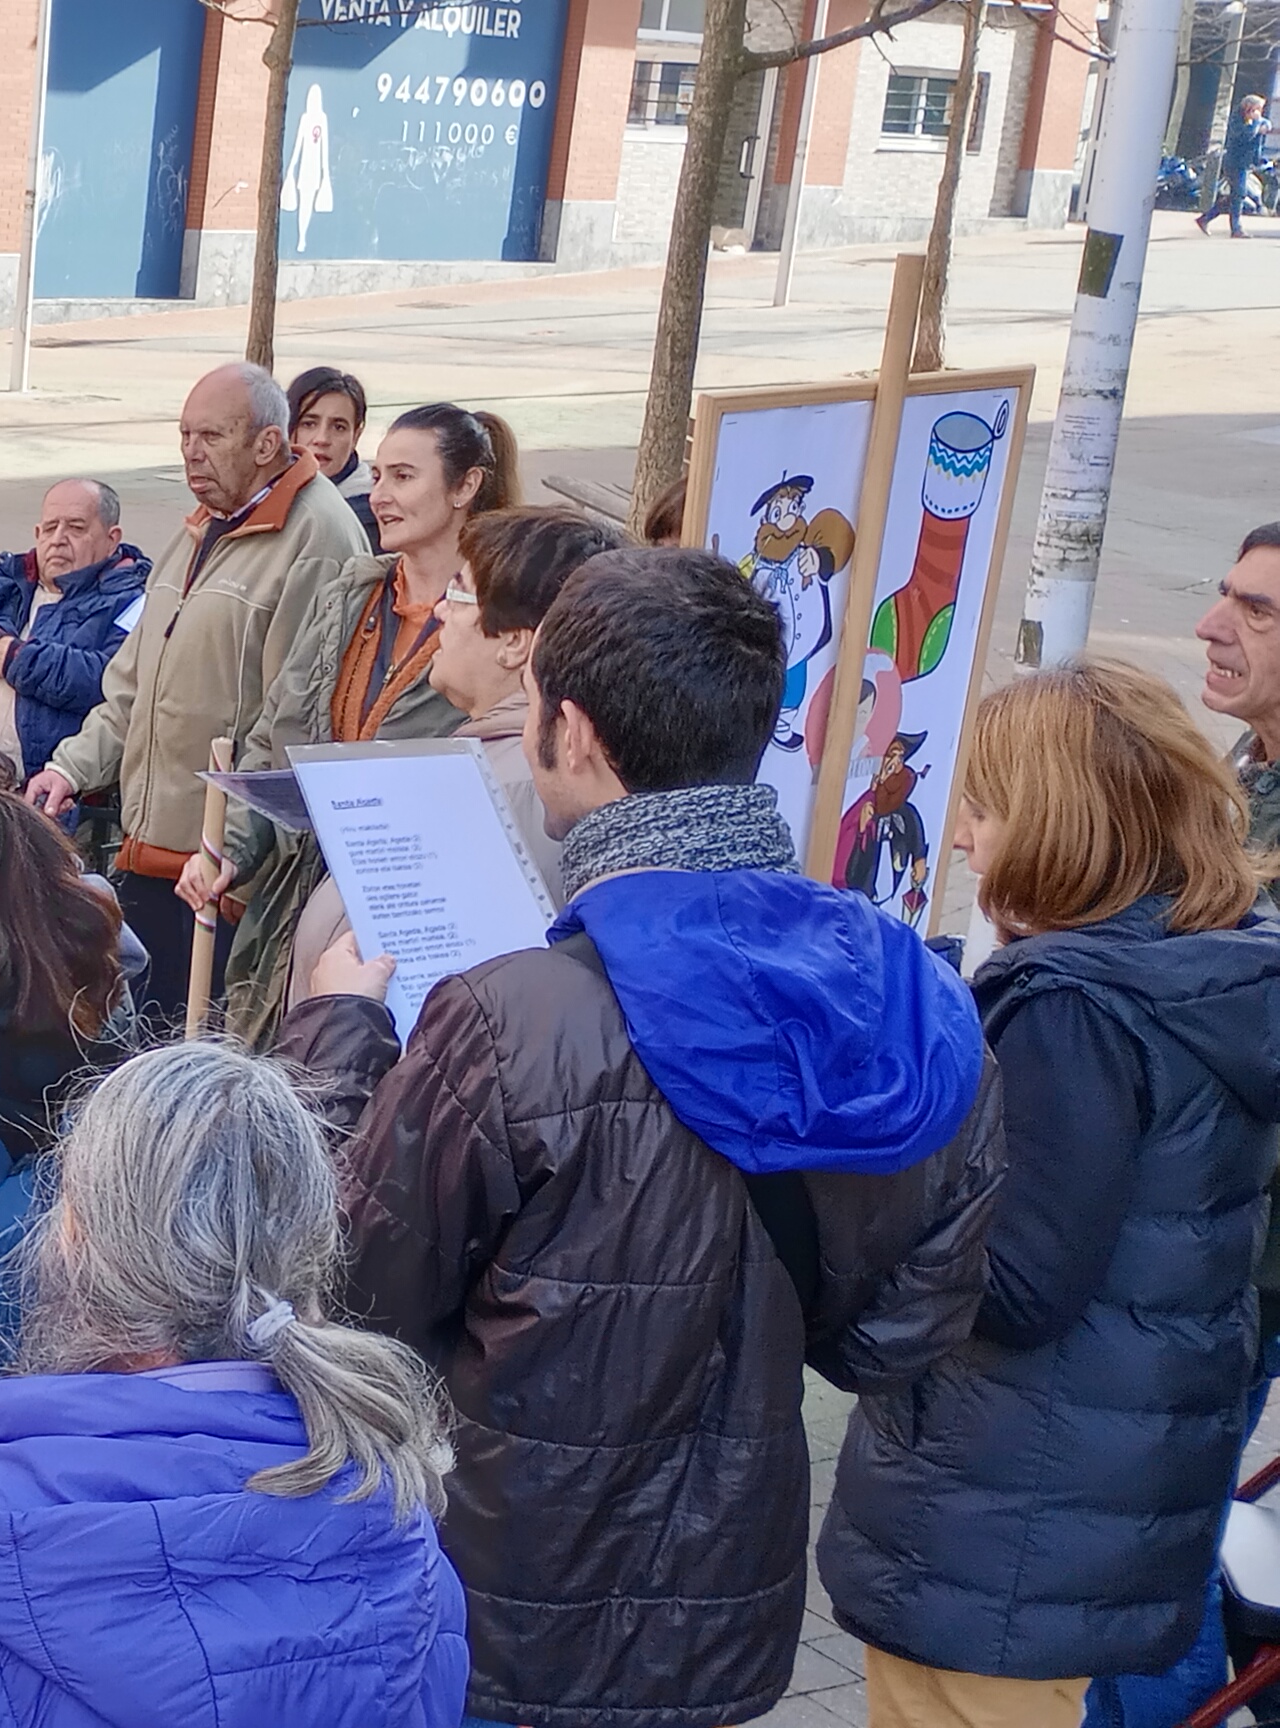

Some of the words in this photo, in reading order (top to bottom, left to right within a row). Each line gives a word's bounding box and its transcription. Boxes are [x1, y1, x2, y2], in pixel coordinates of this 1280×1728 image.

[320, 0, 391, 27] VENTA
[398, 0, 414, 28] Y
[414, 2, 521, 39] ALQUILER
[376, 72, 546, 108] 944790600
[401, 120, 495, 145] 111000
[505, 124, 518, 146] €
